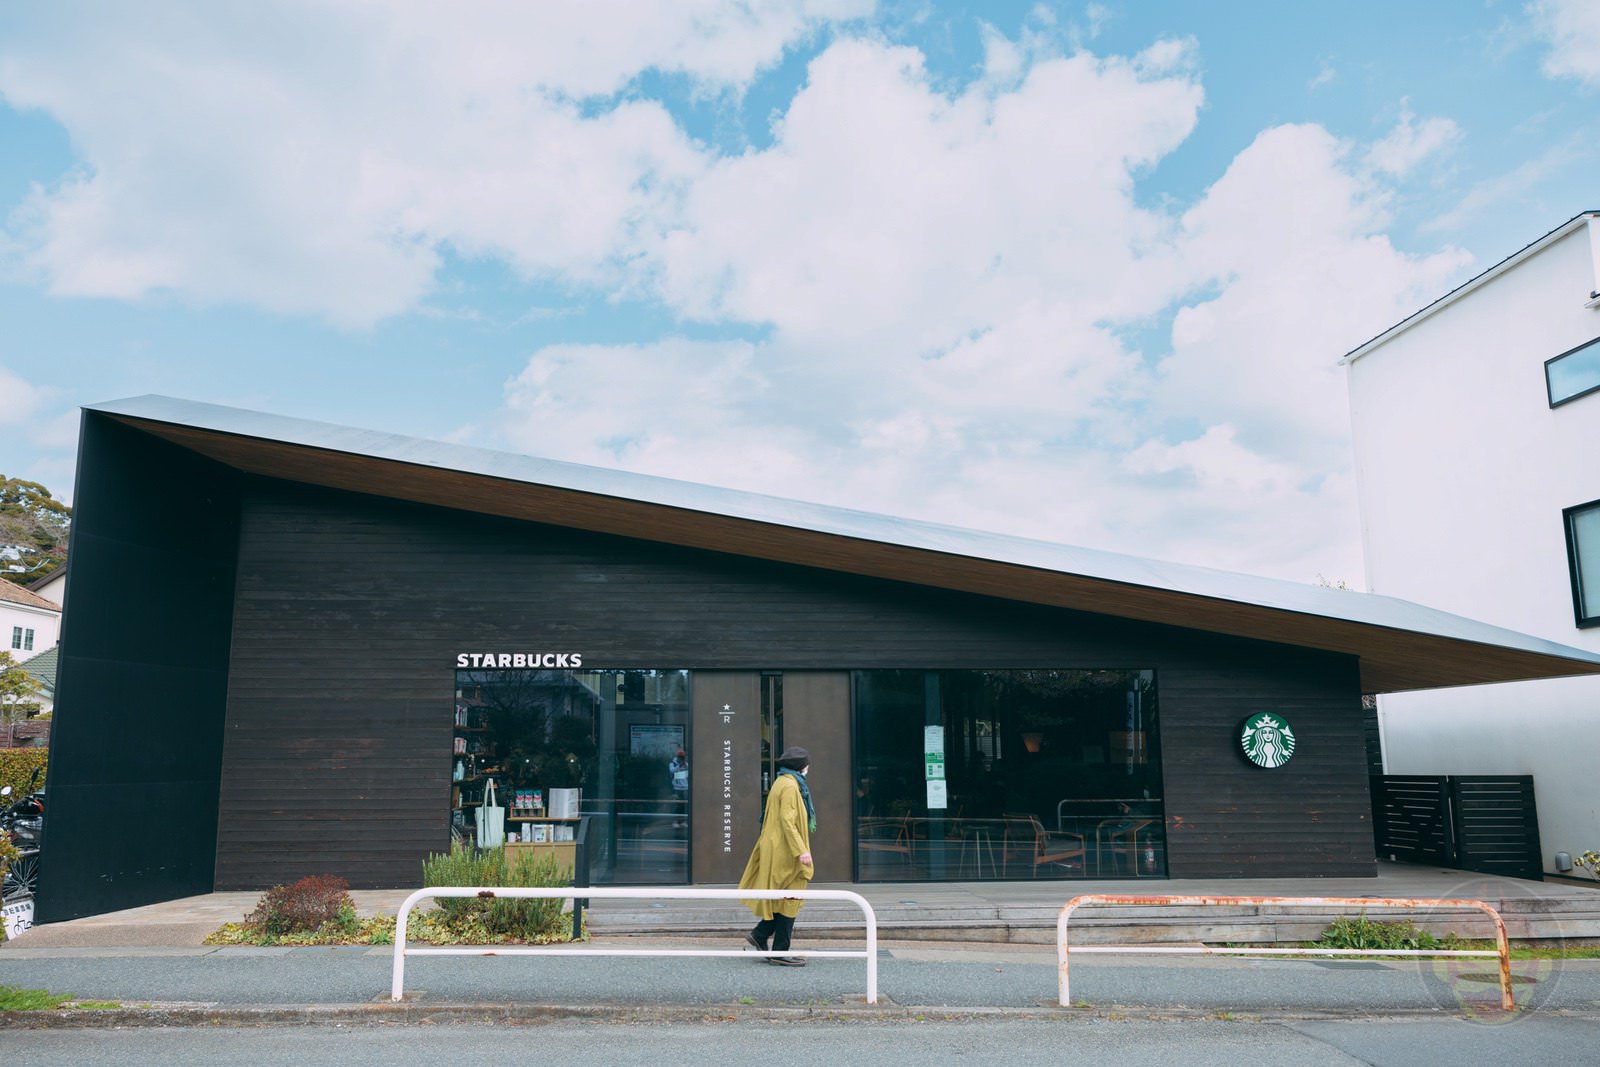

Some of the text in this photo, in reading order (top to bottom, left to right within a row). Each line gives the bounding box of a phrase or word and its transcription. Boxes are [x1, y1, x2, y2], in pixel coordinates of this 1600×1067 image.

[457, 653, 582, 668] STARBUCKS
[723, 715, 731, 724] R
[723, 740, 731, 852] STARBUCKS RESERVE
